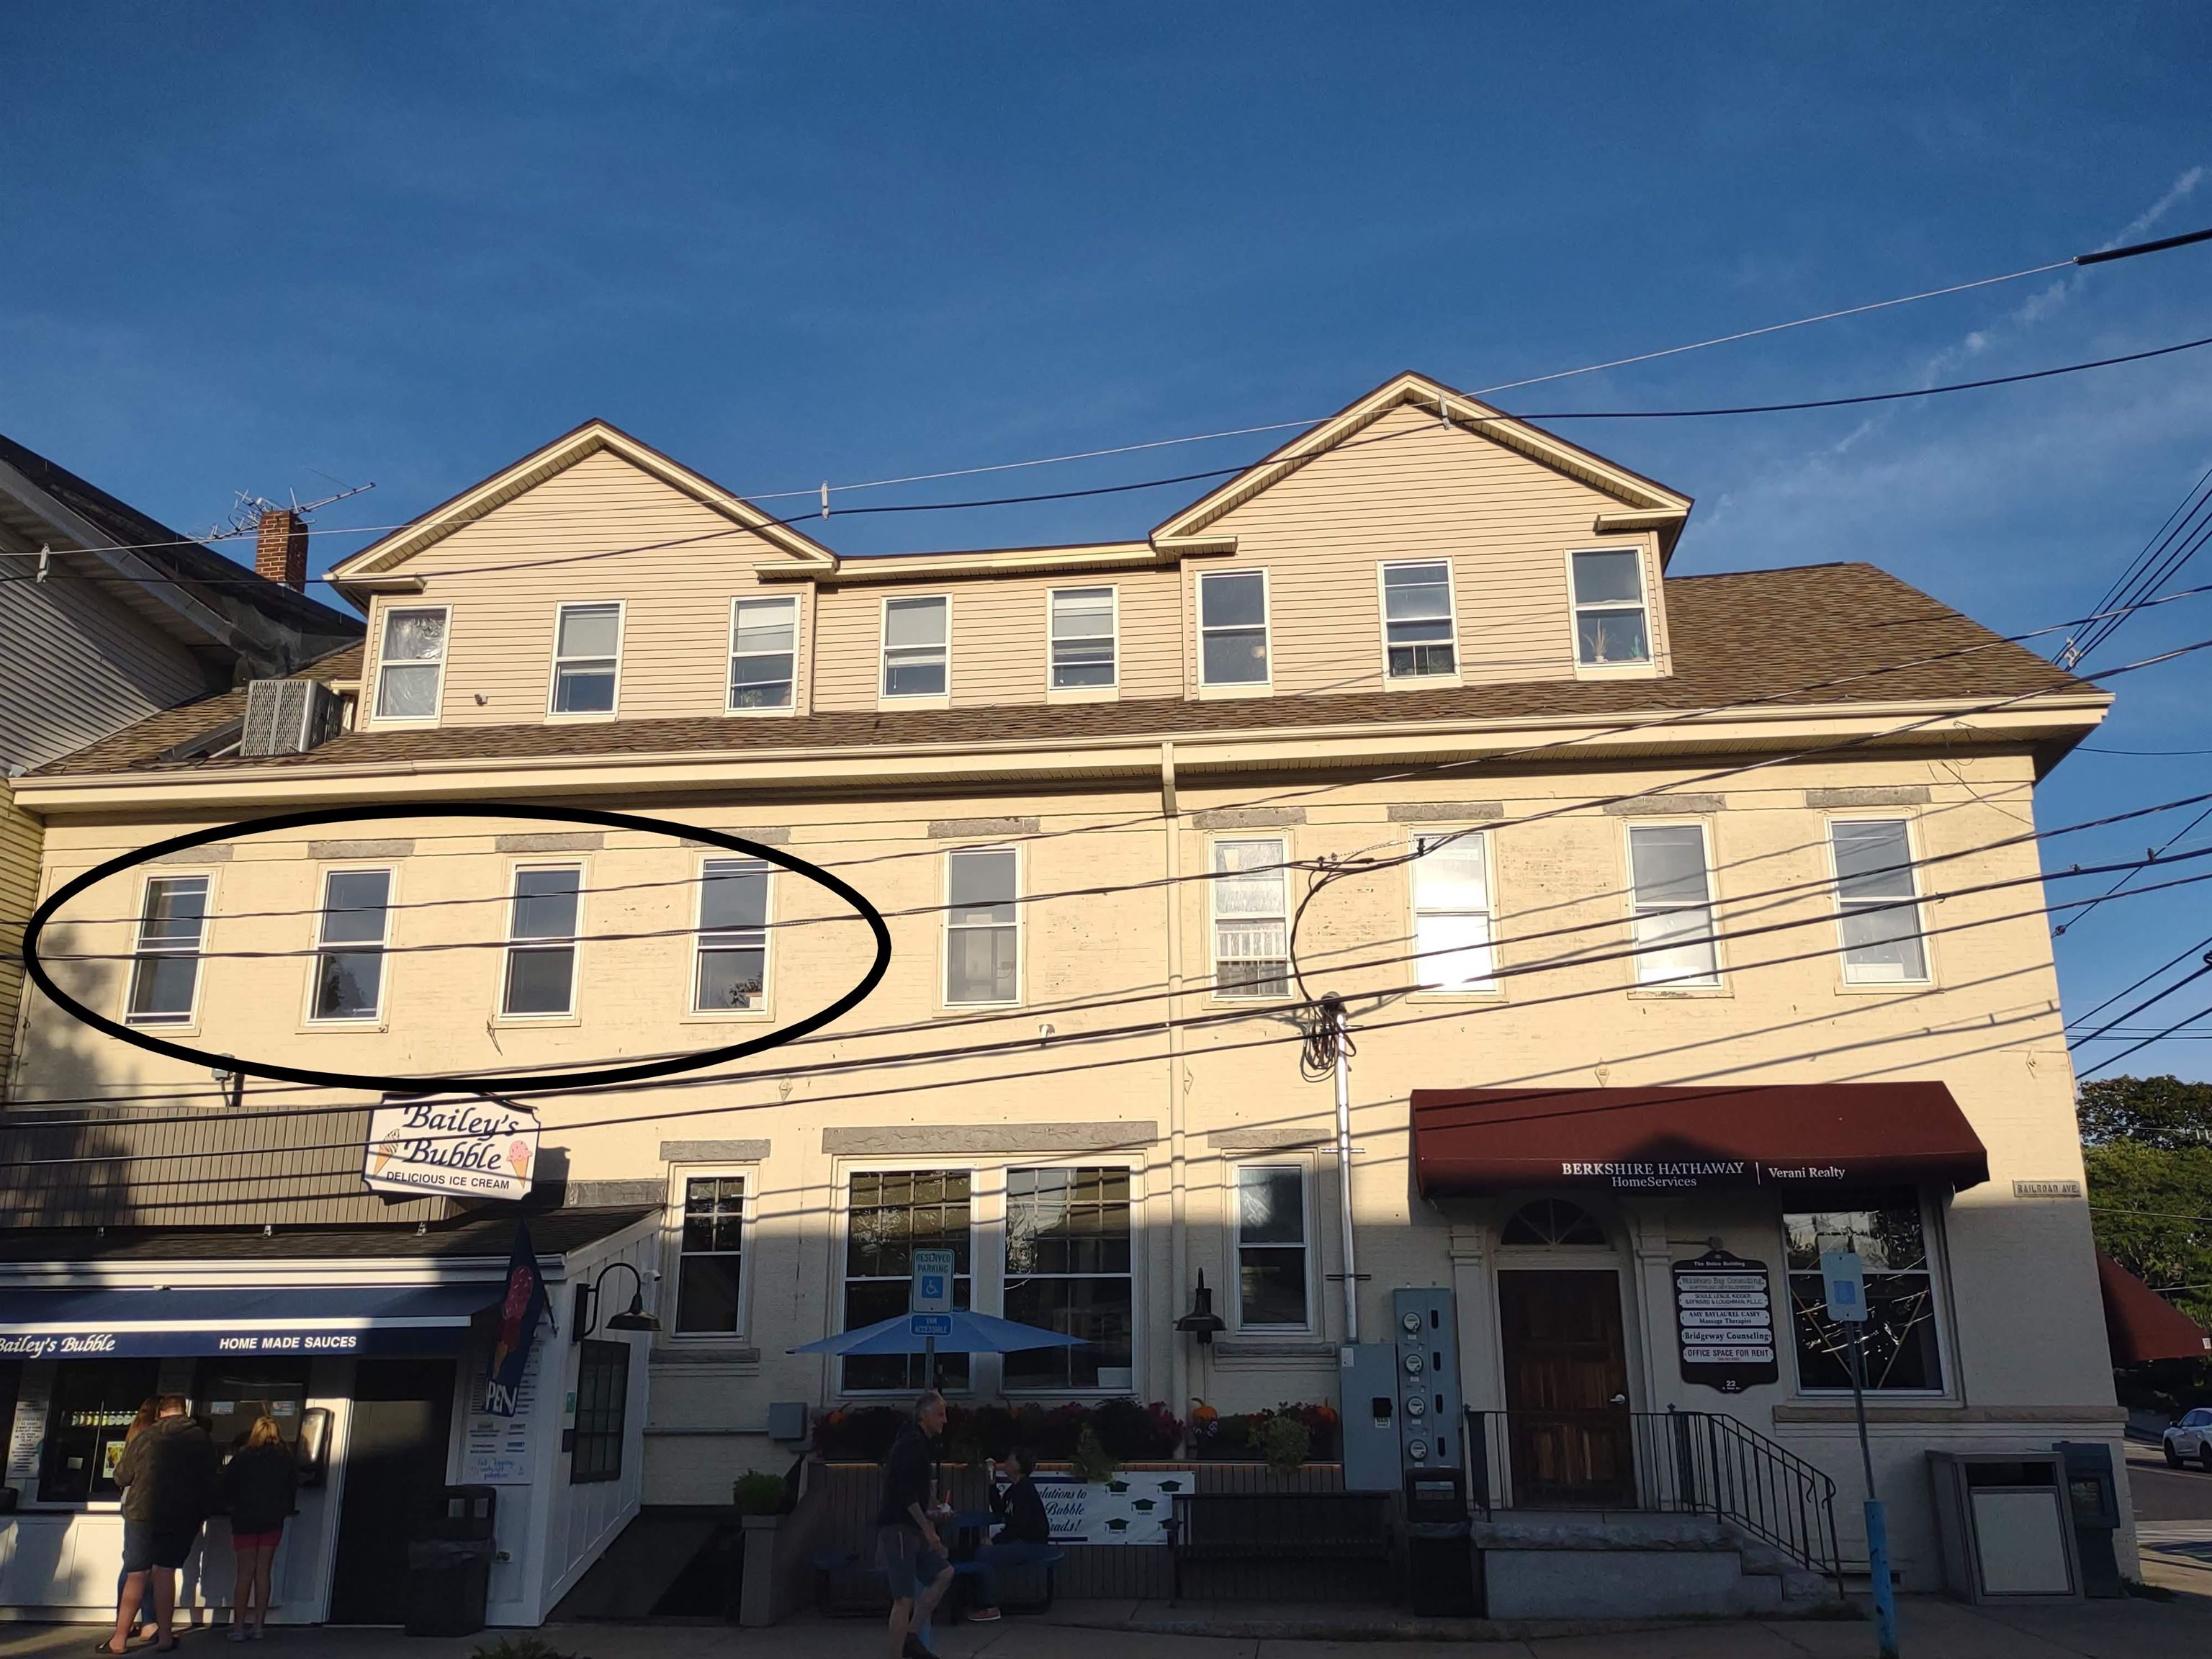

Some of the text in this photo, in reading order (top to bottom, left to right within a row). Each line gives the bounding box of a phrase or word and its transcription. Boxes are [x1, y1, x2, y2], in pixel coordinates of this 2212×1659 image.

[403, 1105, 519, 1141] Bailey's
[403, 1138, 501, 1170] Bubble
[1562, 1162, 1845, 1179] BERKSHIRE HATHAWAY Verani Realty
[386, 1171, 510, 1190] DELICIOUS ICE CREAM
[1612, 1177, 1697, 1187] HomeServices
[2018, 1184, 2059, 1193] RAILROAD
[916, 1254, 950, 1262] RESERVED
[918, 1264, 948, 1273] PARKING
[60, 1334, 116, 1352] Bubble
[220, 1336, 357, 1349] HOME MADE SAUCES
[1685, 1332, 1769, 1341] Bridgeway Counseling
[485, 1379, 517, 1415] PEN
[1077, 1488, 1087, 1498] to
[1046, 1502, 1084, 1515] Bubble
